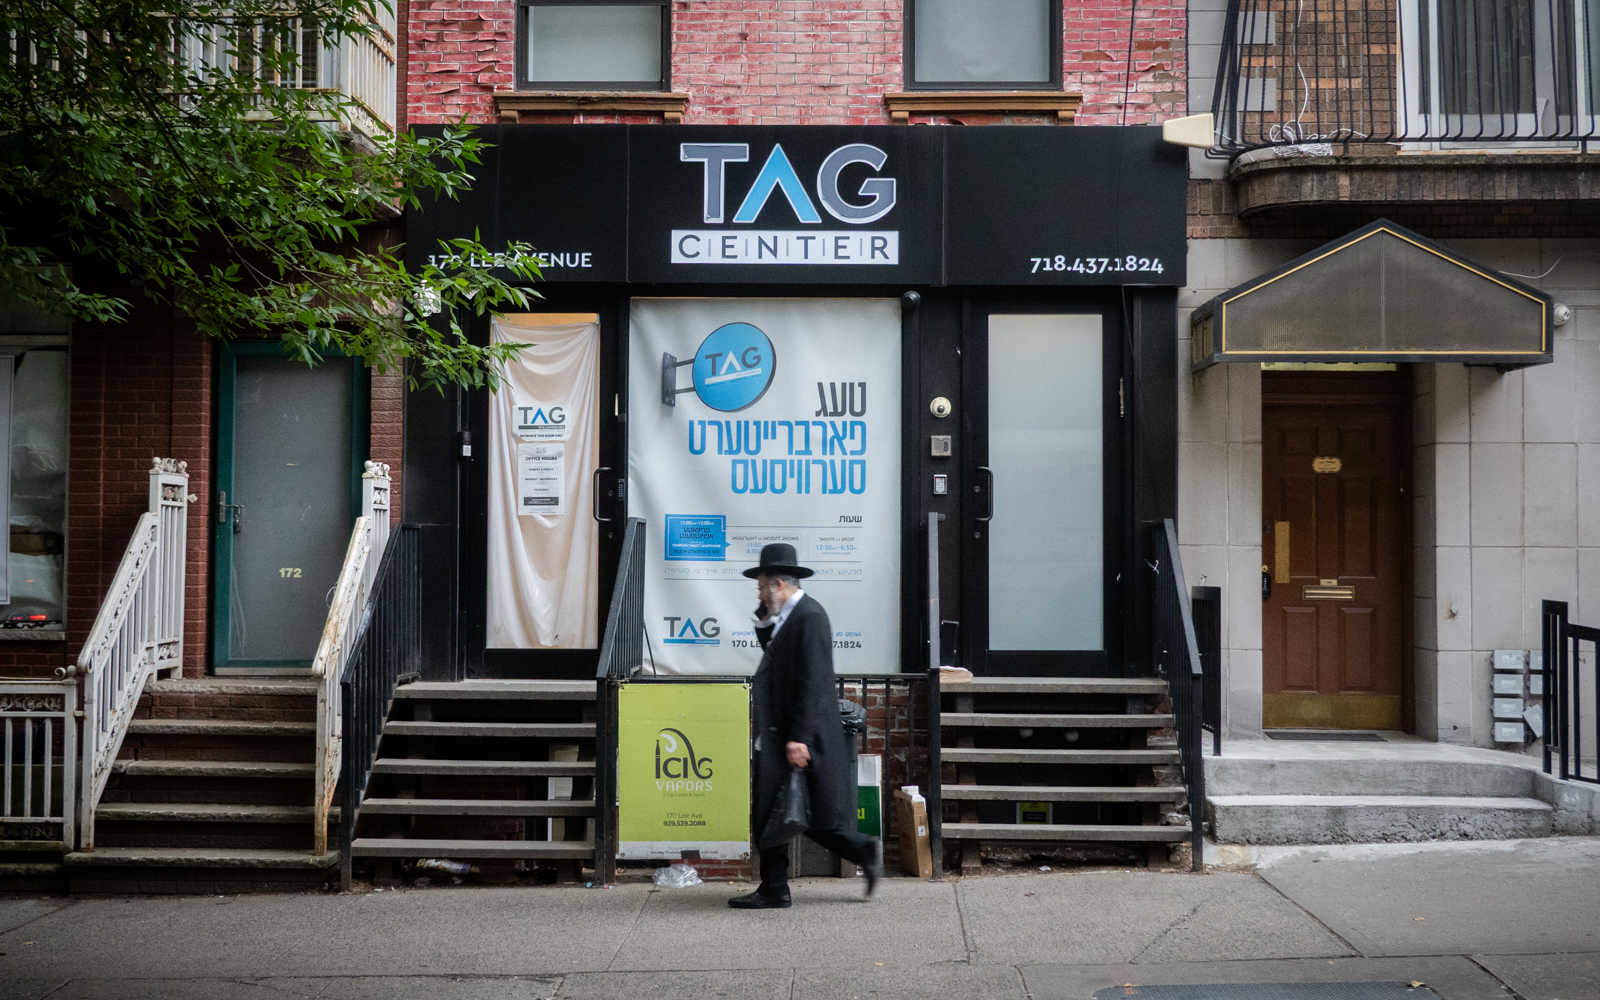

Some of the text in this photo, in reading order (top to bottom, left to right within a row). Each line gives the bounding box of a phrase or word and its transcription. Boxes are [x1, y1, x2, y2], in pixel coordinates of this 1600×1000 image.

[680, 142, 897, 225] TAG
[677, 233, 890, 260] CENTER
[512, 252, 593, 268] AVENUE
[1029, 254, 1165, 274] 718.437.1824
[704, 345, 762, 377] TAG
[815, 381, 867, 418] טעג
[518, 406, 566, 424] TAG
[688, 419, 867, 456] פארברייטערט
[730, 459, 867, 495] סערוויסעס
[838, 515, 862, 523] שעות
[279, 567, 302, 578] 172
[663, 616, 721, 639] TAG
[731, 640, 747, 648] 170
[655, 780, 713, 792] VAPORS
